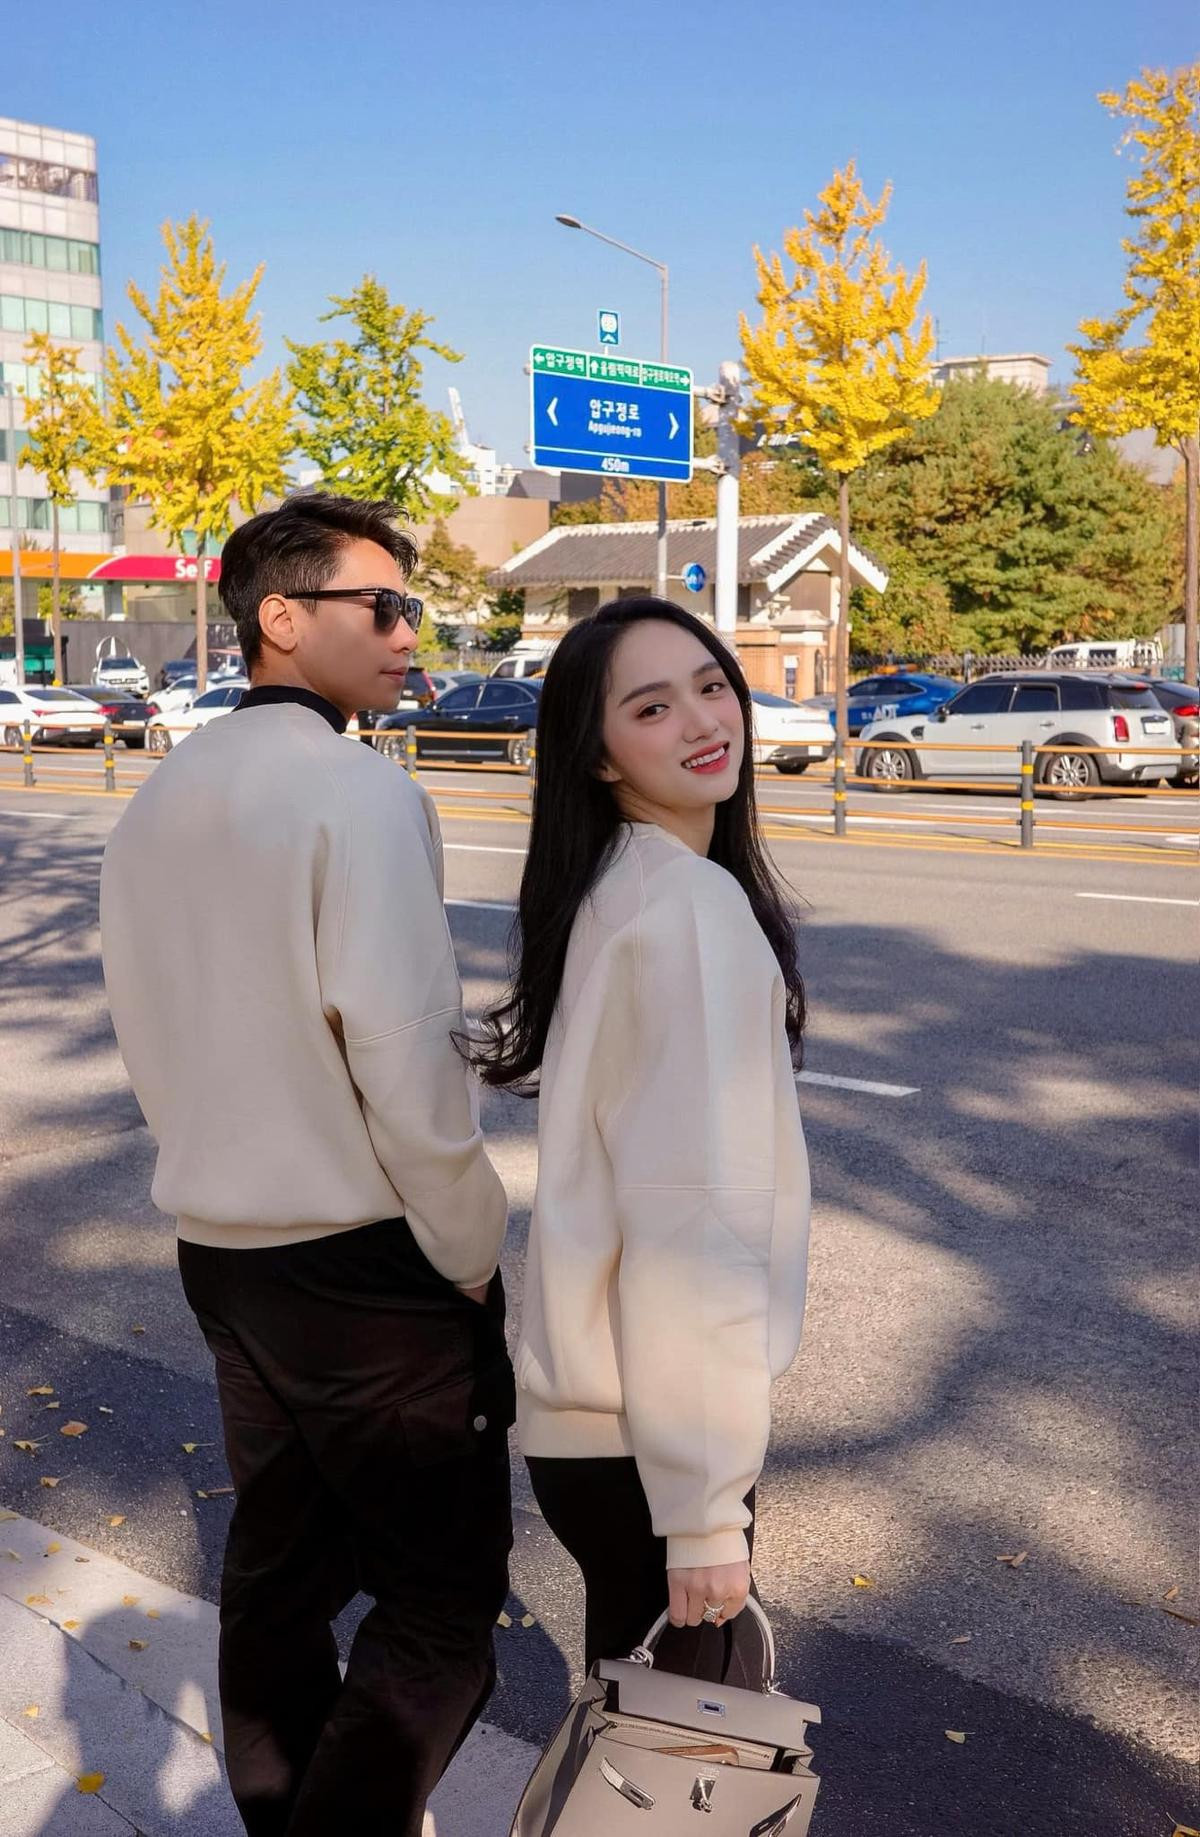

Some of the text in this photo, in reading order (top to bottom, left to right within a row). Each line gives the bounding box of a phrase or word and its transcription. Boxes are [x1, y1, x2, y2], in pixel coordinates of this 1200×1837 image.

[545, 352, 584, 372] 압구정역
[589, 399, 640, 422] 압구정로
[601, 457, 630, 473] 450m
[175, 558, 213, 579] Sef
